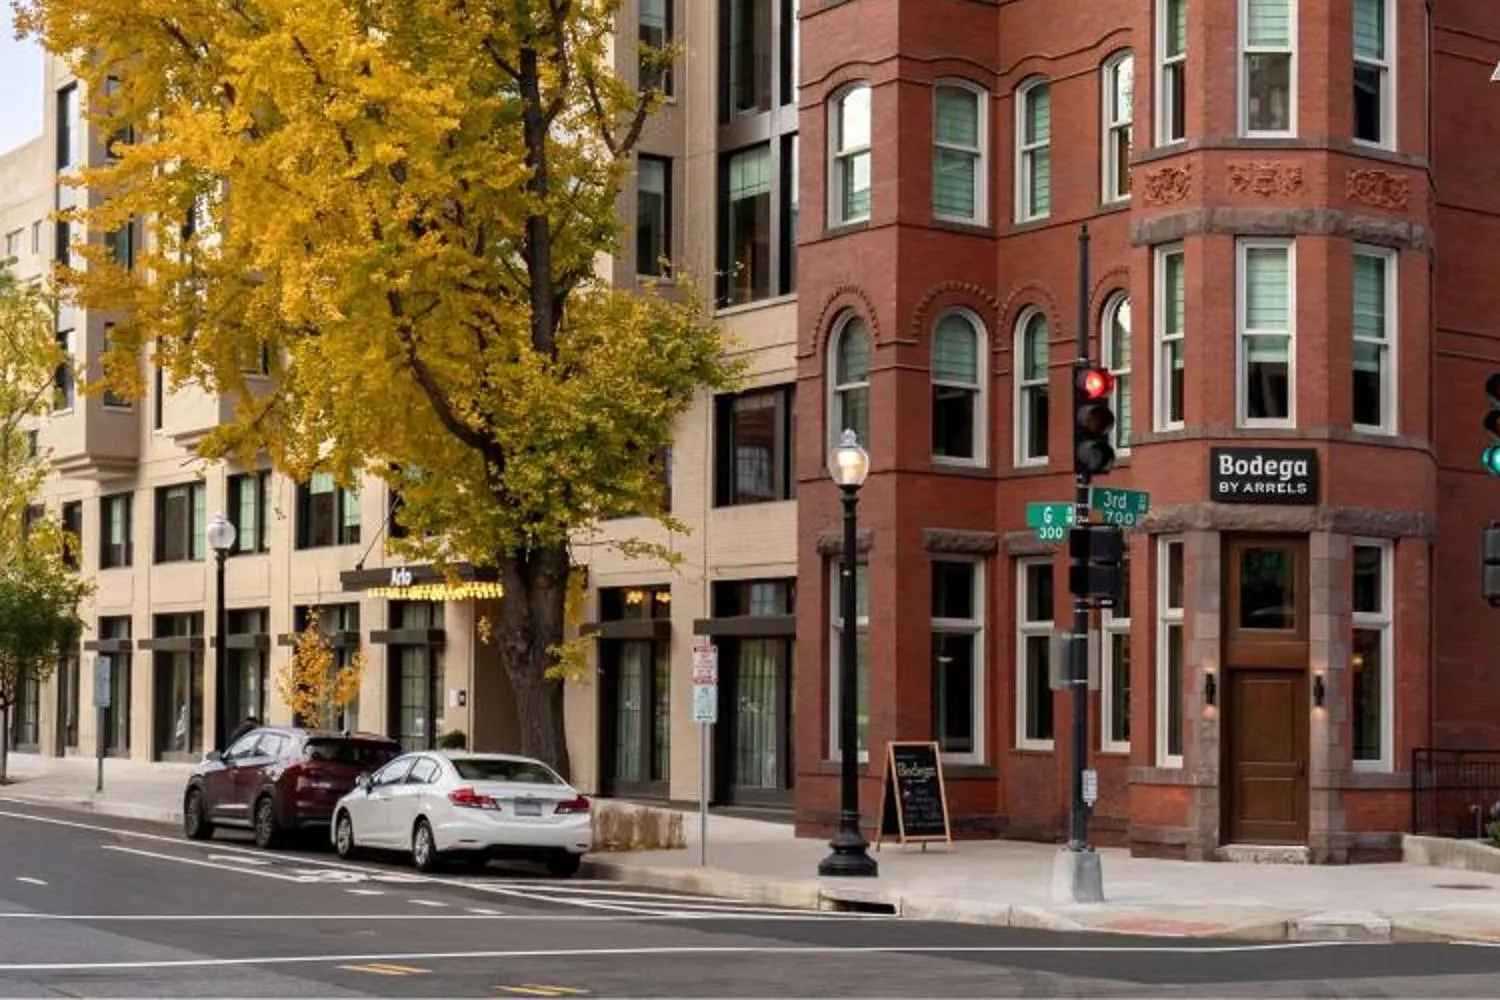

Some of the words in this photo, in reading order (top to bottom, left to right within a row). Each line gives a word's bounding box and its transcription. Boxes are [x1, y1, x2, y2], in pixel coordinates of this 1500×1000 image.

[1218, 454, 1308, 481] Bodega
[1219, 481, 1239, 493] BY
[1243, 482, 1308, 495] ARRELS
[1103, 491, 1127, 509] 3rd
[1043, 506, 1053, 524] G
[1105, 511, 1134, 525] 700
[1039, 526, 1063, 539] 300
